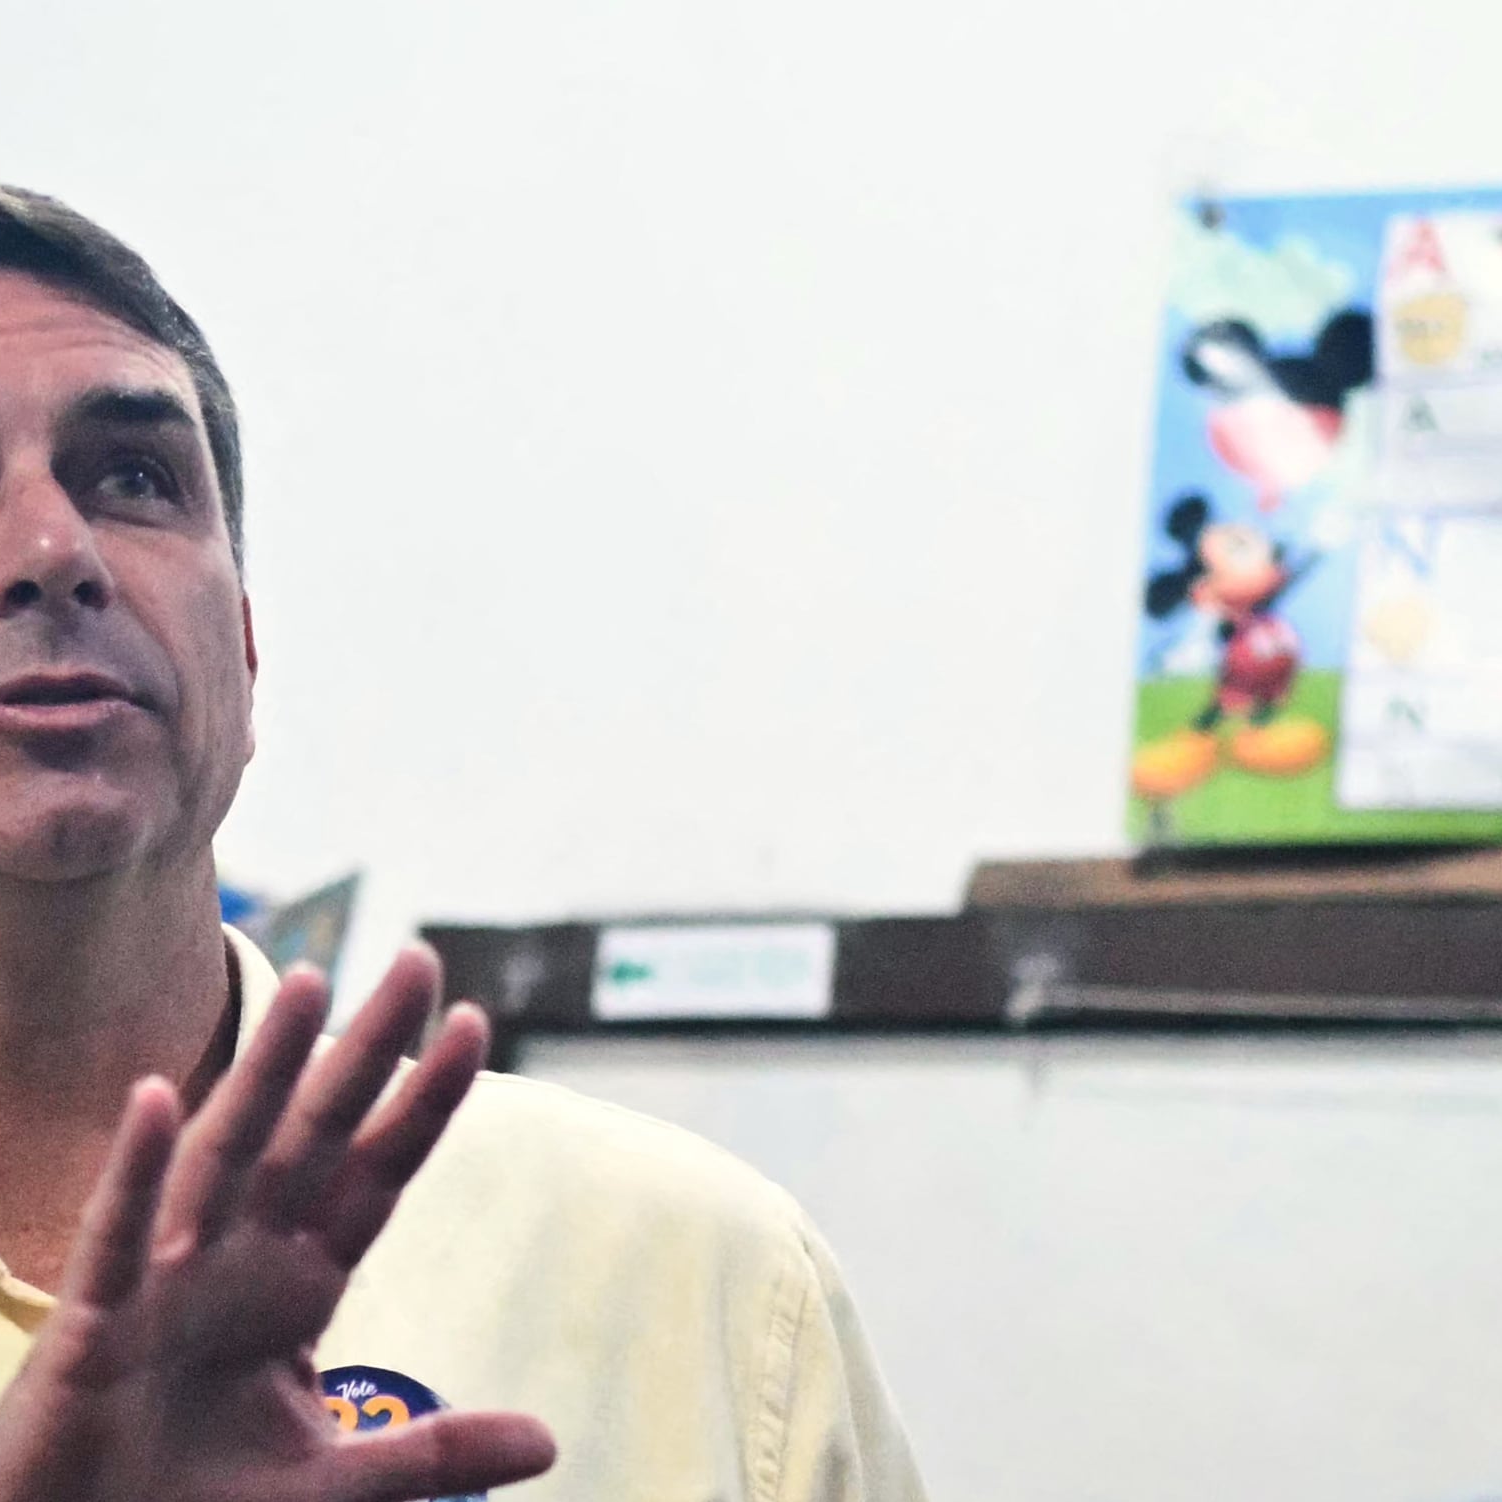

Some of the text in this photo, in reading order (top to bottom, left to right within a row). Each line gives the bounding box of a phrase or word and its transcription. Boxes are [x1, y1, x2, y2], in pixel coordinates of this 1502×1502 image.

[1387, 214, 1448, 287] A
[1380, 508, 1441, 579] N
[336, 1380, 377, 1401] Vote
